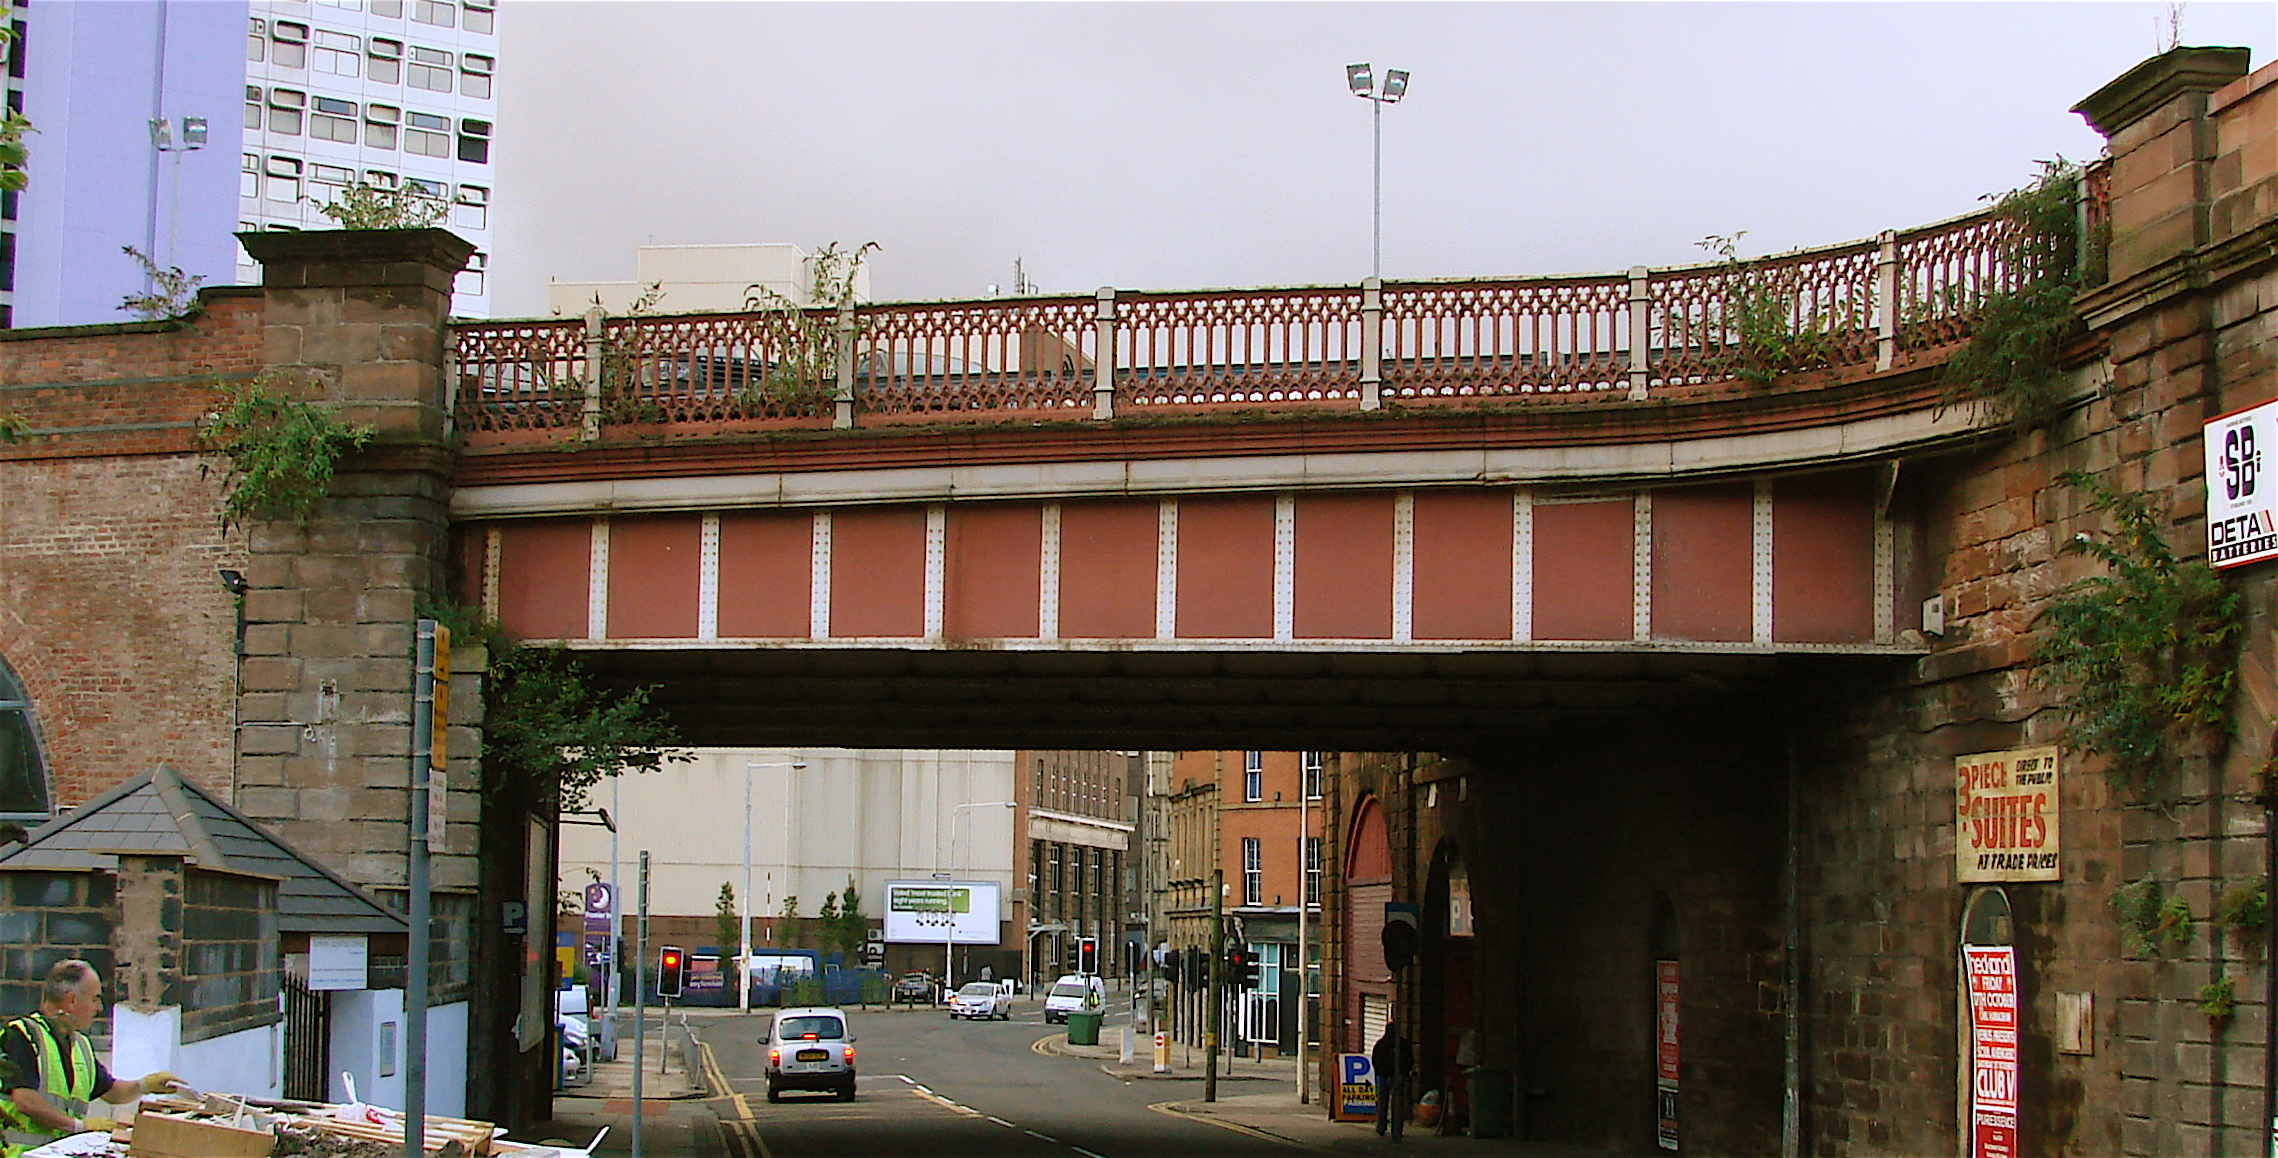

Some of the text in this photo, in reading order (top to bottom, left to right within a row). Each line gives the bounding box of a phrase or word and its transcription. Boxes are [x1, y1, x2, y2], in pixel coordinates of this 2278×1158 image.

[2211, 513, 2261, 545] DETA
[2212, 535, 2277, 562] BATTERIES
[1958, 761, 2008, 815] 3 PIECE
[1970, 792, 2047, 849] SUITES
[1977, 852, 2058, 870] AT TRADE PRICES
[502, 901, 525, 927] P
[1344, 1056, 1371, 1084] P
[1977, 1068, 2014, 1101] CLUB V
